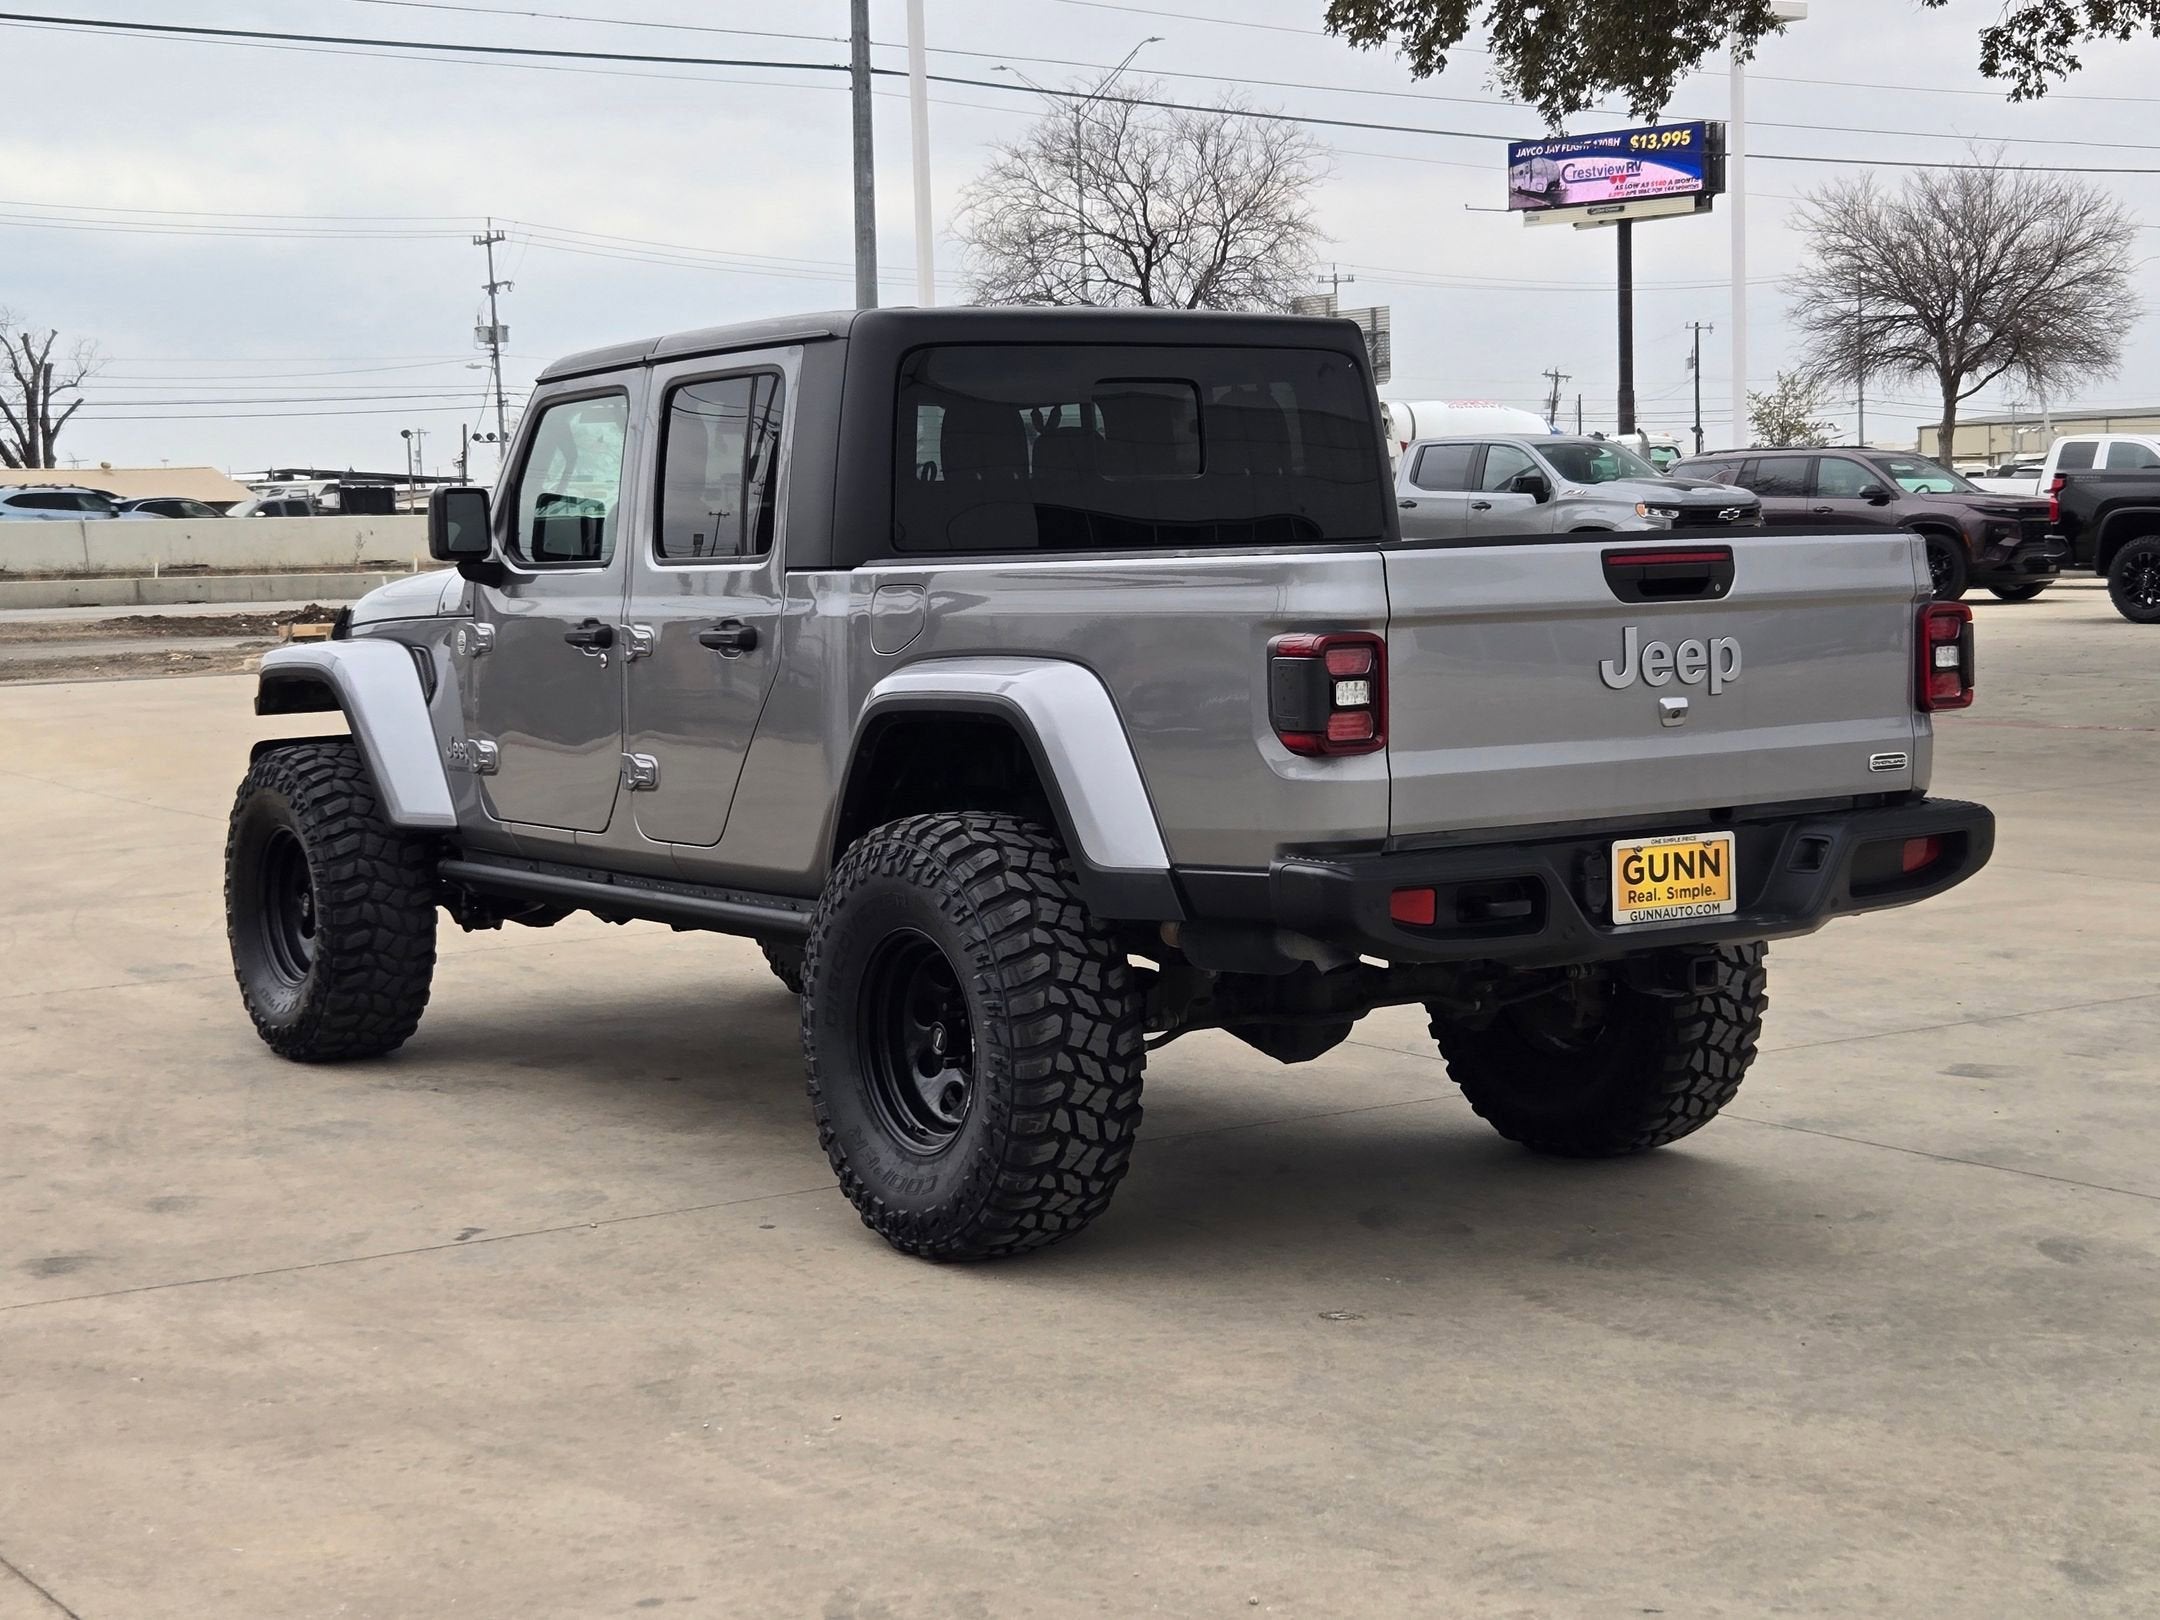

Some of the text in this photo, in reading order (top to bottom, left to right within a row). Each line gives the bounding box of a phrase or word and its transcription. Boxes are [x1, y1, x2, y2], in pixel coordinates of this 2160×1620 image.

[1515, 146, 1543, 158] JAYCO
[1544, 145, 1561, 154] JAY
[1630, 130, 1691, 152] $13,995
[1600, 626, 1742, 696] Jeep
[1623, 849, 1720, 885] GUNN
[1628, 883, 1716, 903] Real. Simple.
[1630, 903, 1720, 921] GUNNAUTO.COM
